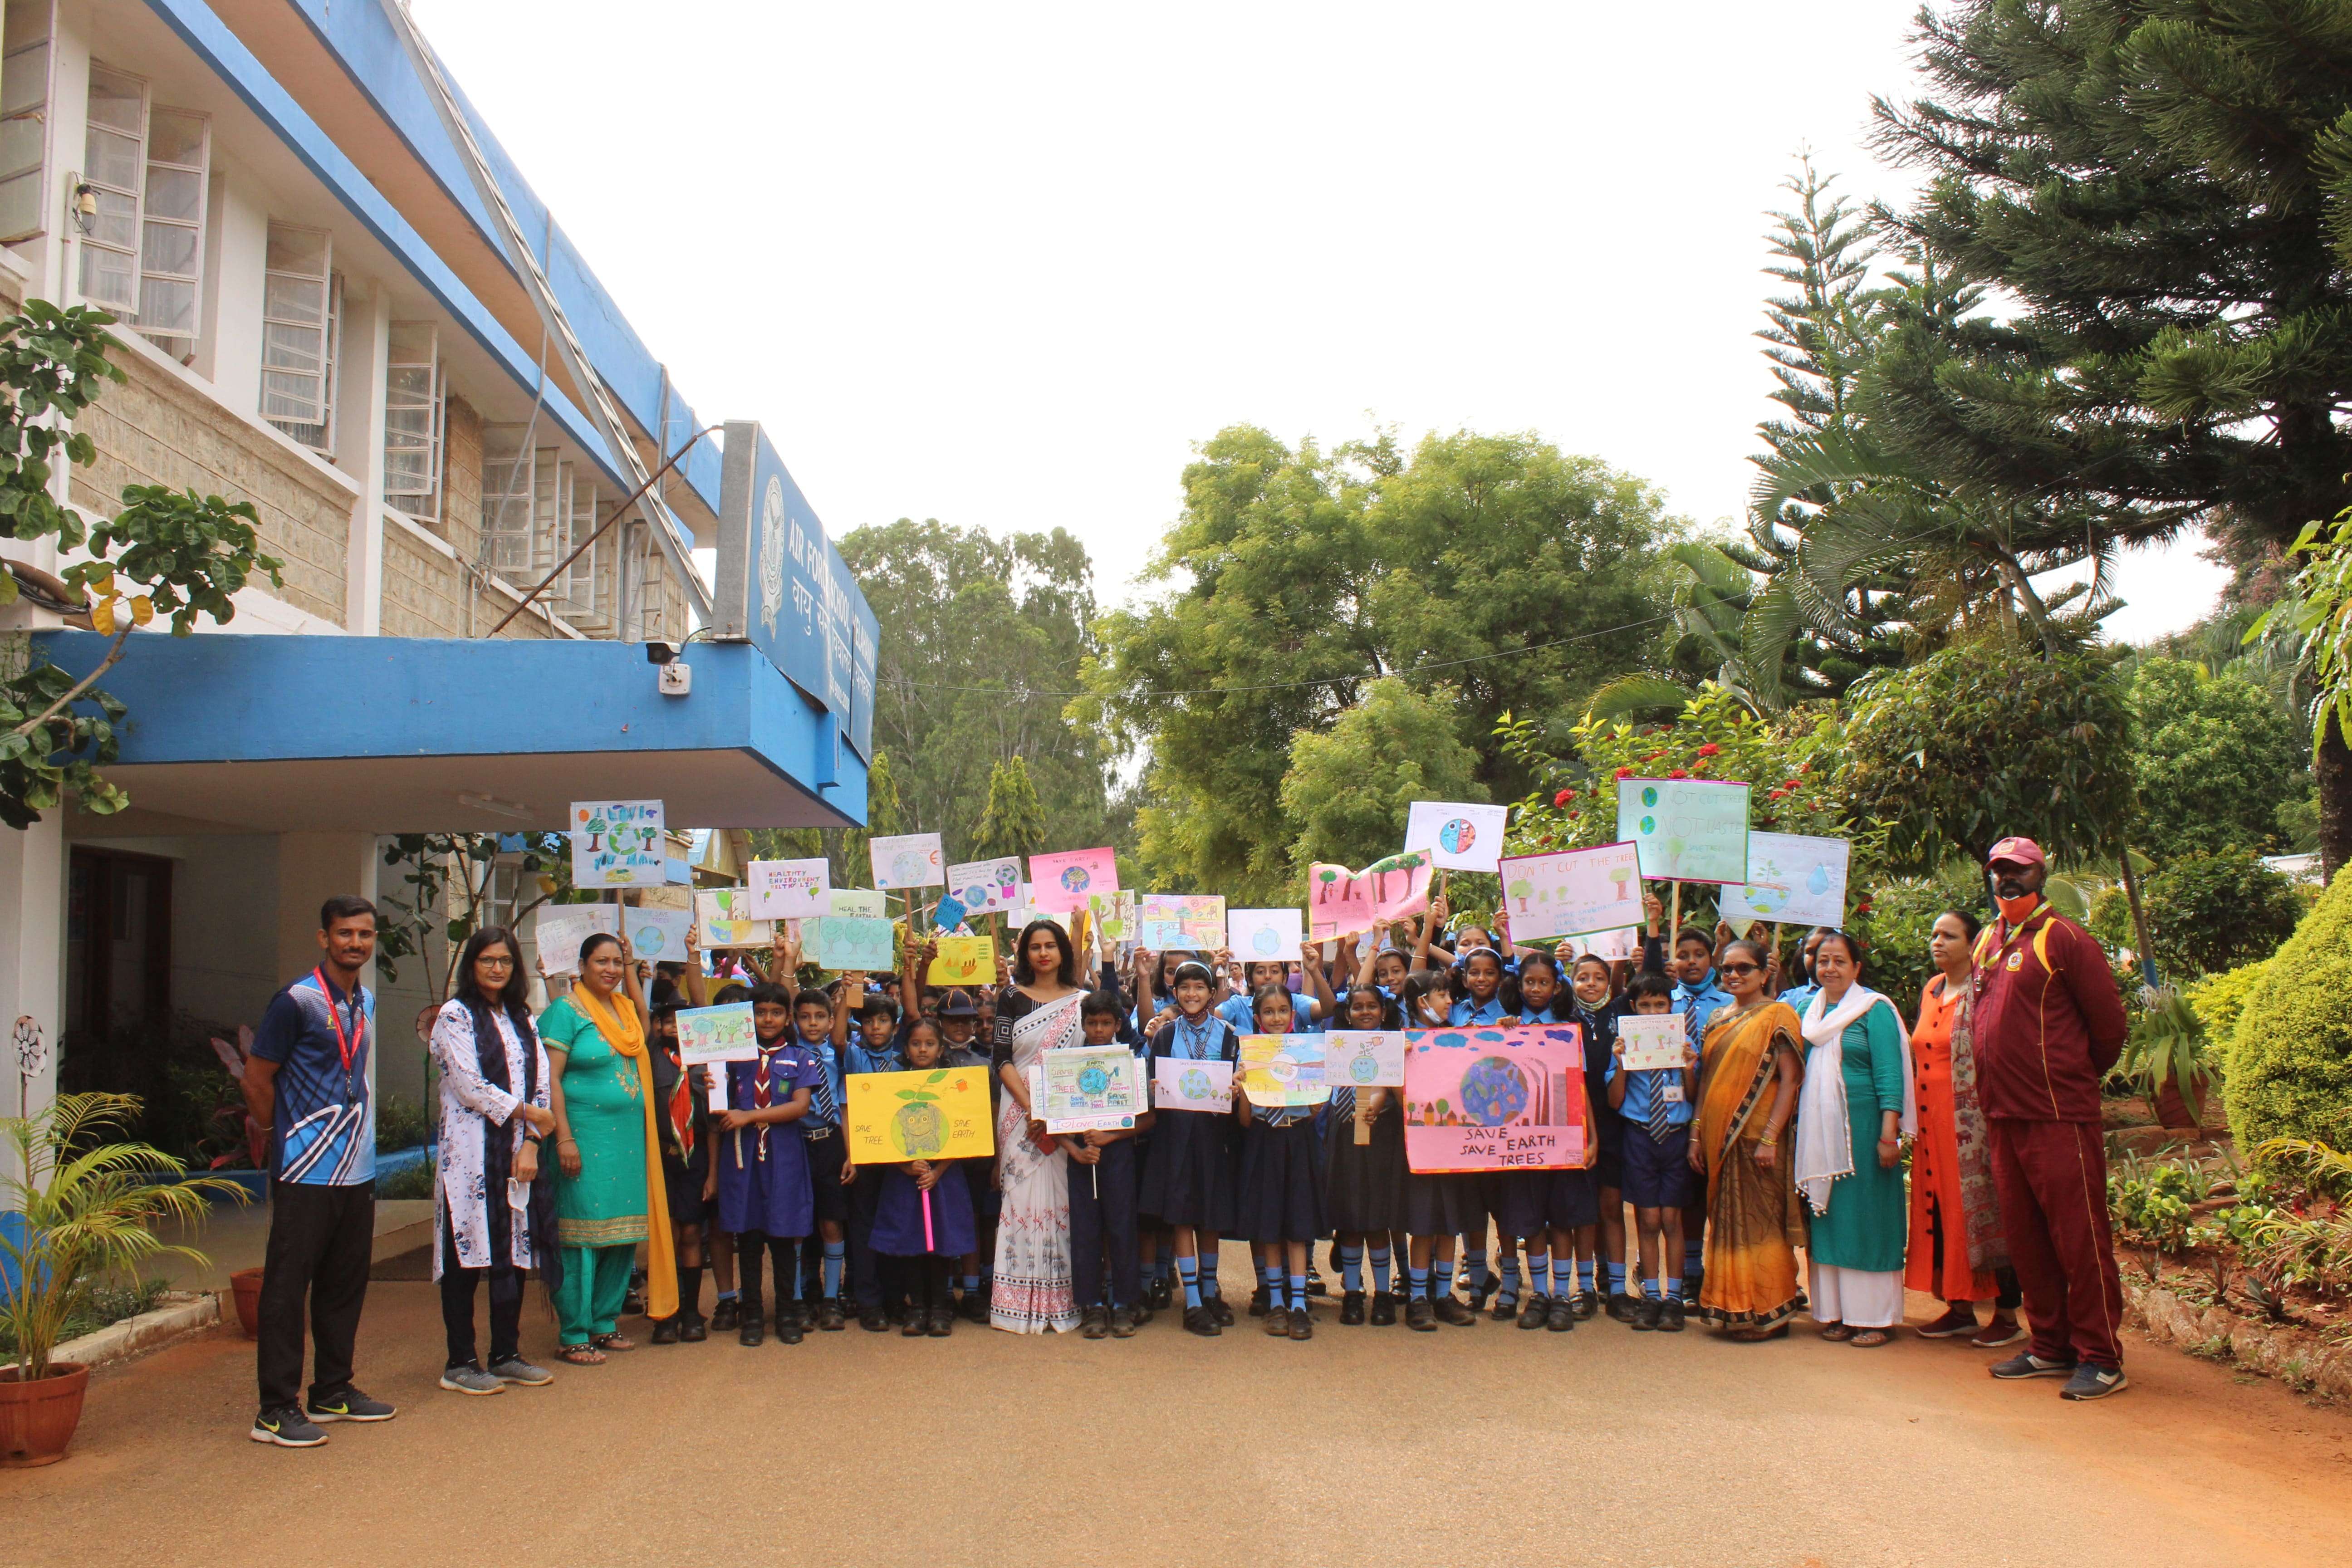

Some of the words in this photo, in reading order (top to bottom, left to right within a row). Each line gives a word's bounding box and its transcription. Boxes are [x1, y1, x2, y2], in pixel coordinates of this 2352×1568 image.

[789, 518, 804, 567] AIR
[1662, 790, 1696, 805] NOT
[1660, 816, 1704, 838] NOT
[1707, 819, 1744, 835] WASTE
[1558, 861, 1578, 872] CUT
[1590, 857, 1610, 867] THE
[1615, 853, 1636, 863] TREES
[942, 898, 964, 916] SAVE
[954, 1119, 971, 1128] SAVE
[1052, 1120, 1062, 1131] I
[863, 1136, 883, 1145] TREE
[953, 1129, 975, 1139] EARTH
[1465, 1127, 1508, 1140] SAVE
[1506, 1135, 1555, 1151] EARTH
[1460, 1145, 1496, 1156] SAVE
[1499, 1152, 1545, 1166] TREES
